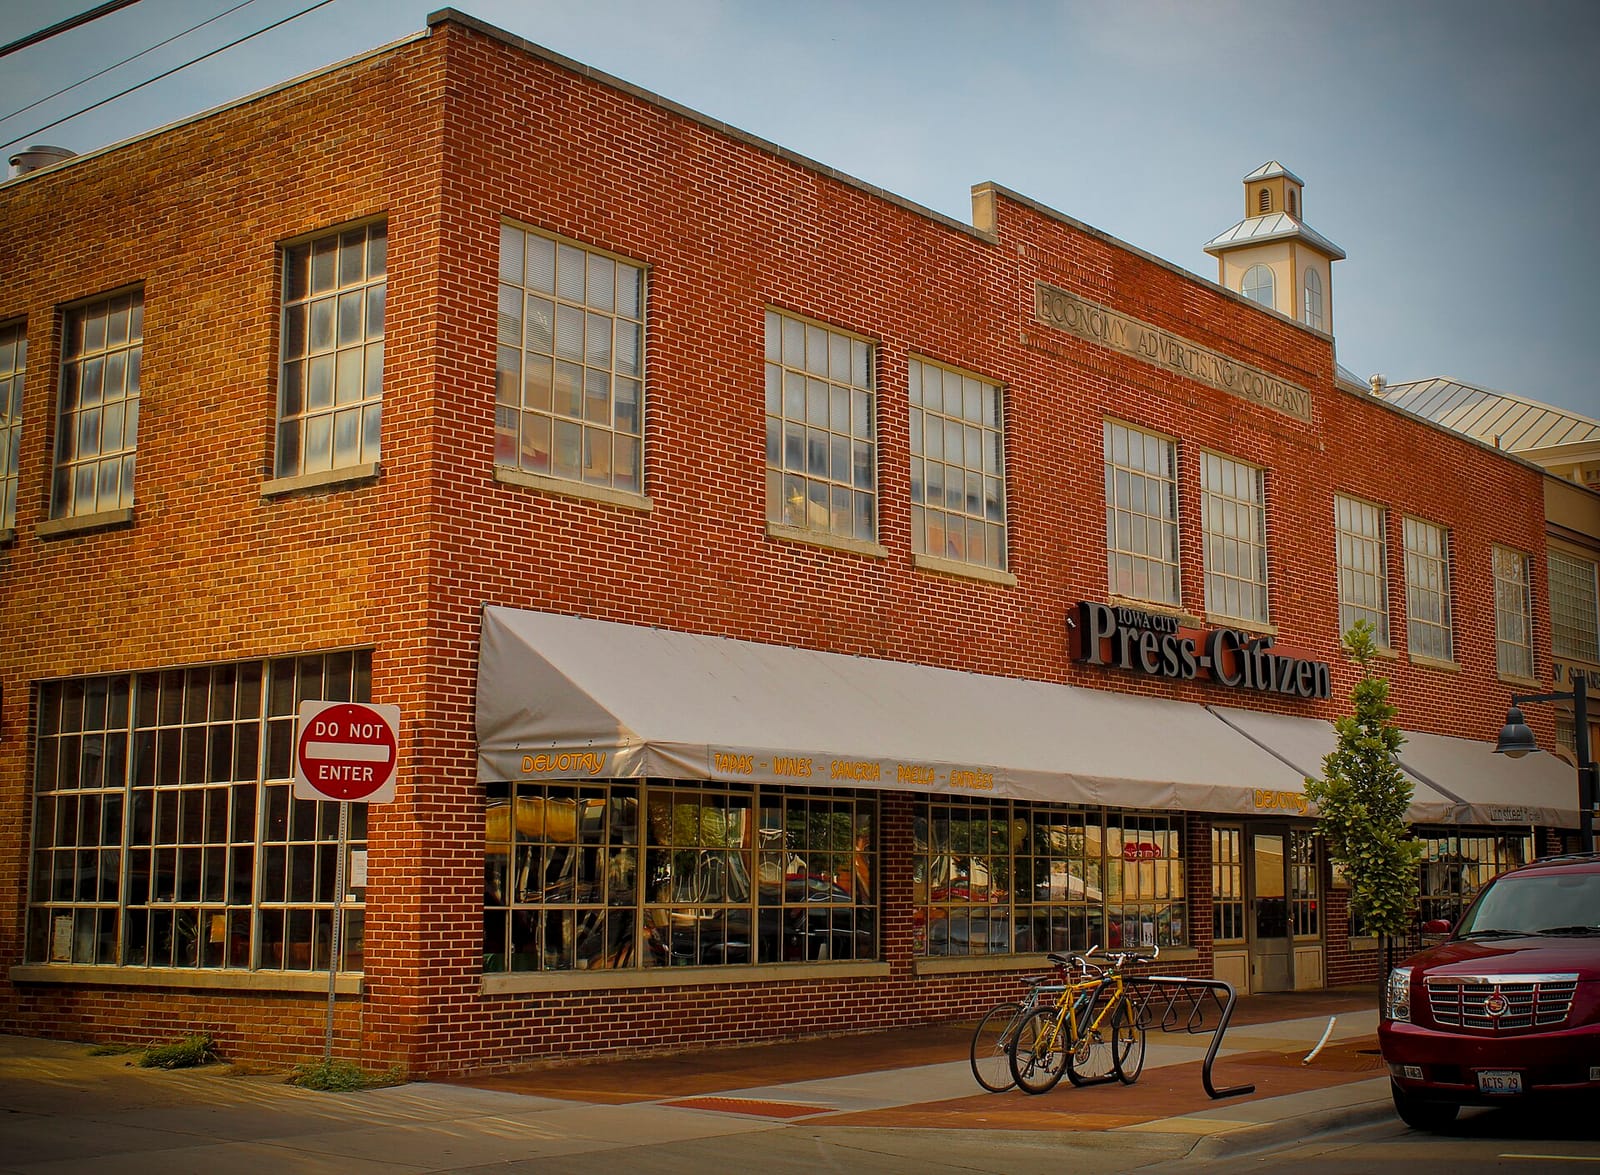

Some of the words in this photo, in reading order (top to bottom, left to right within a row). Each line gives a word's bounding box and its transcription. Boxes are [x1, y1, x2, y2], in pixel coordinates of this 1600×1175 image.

[1041, 290, 1128, 346] ECONOMY
[1138, 328, 1234, 388] ADVERTISING
[1241, 370, 1308, 416] COMPANY
[1118, 607, 1151, 629] IOWA
[1152, 615, 1180, 634] CITY
[1080, 601, 1332, 700] Press-Citizen
[315, 722, 339, 737] DO
[349, 723, 384, 739] NOT
[319, 765, 373, 782] ENTER
[521, 752, 607, 776] DEVOTAY
[714, 752, 754, 775] TAPAS
[772, 755, 813, 778] WINES
[831, 760, 881, 783] SANGRIA
[897, 764, 936, 786] PAELLA
